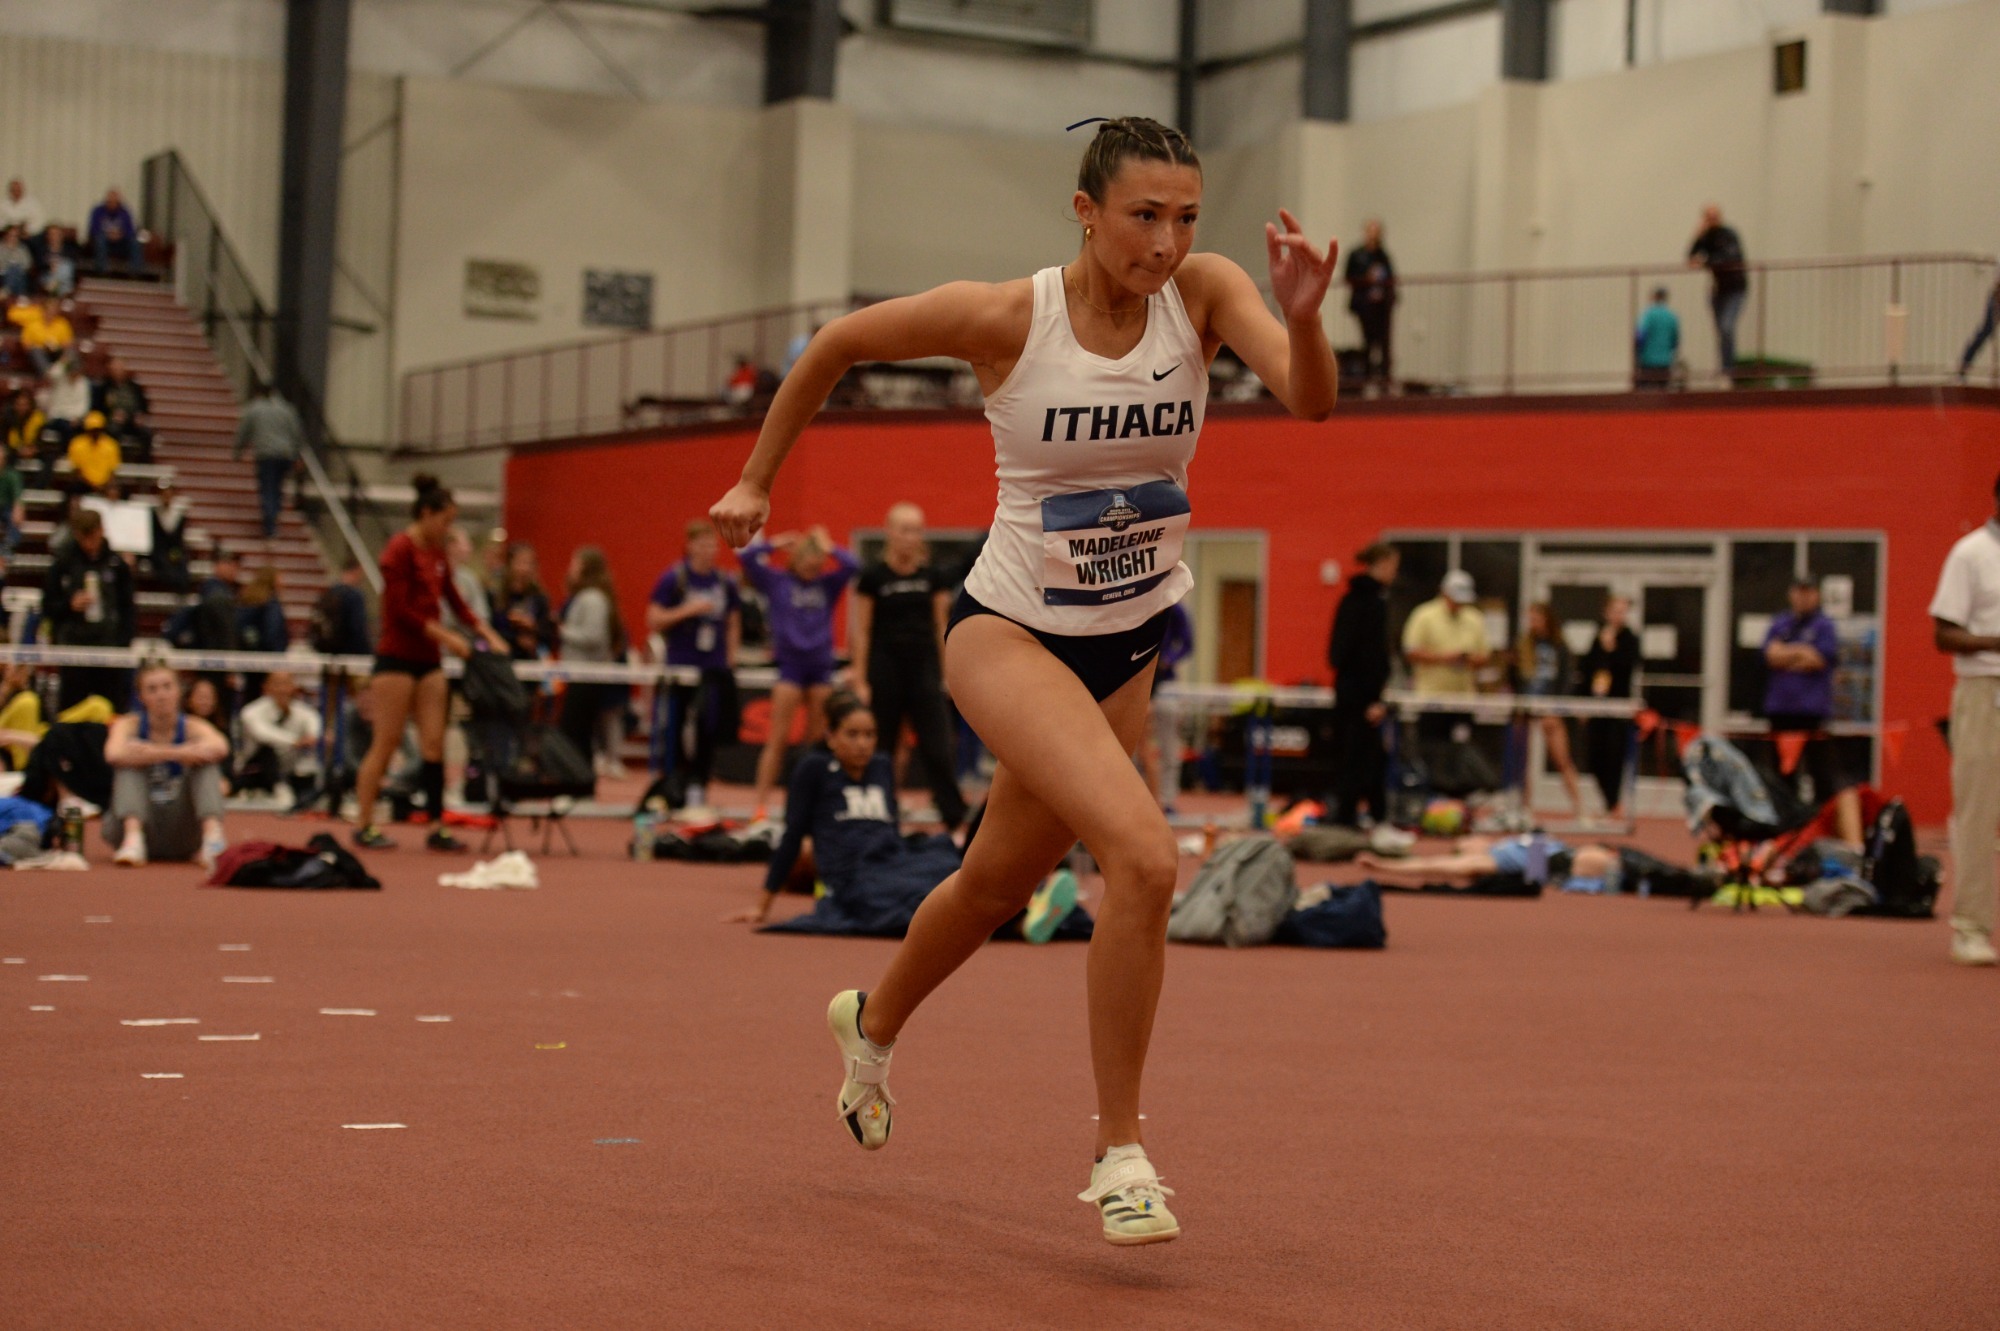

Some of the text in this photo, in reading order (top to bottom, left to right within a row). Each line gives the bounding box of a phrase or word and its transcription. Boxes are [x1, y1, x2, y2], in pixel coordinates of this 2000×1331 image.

[1041, 400, 1195, 442] ITHACA
[1100, 512, 1140, 522] CHAMPIONSHIPS
[1068, 527, 1166, 558] MADELEINE
[1075, 546, 1157, 585] WRIGHT
